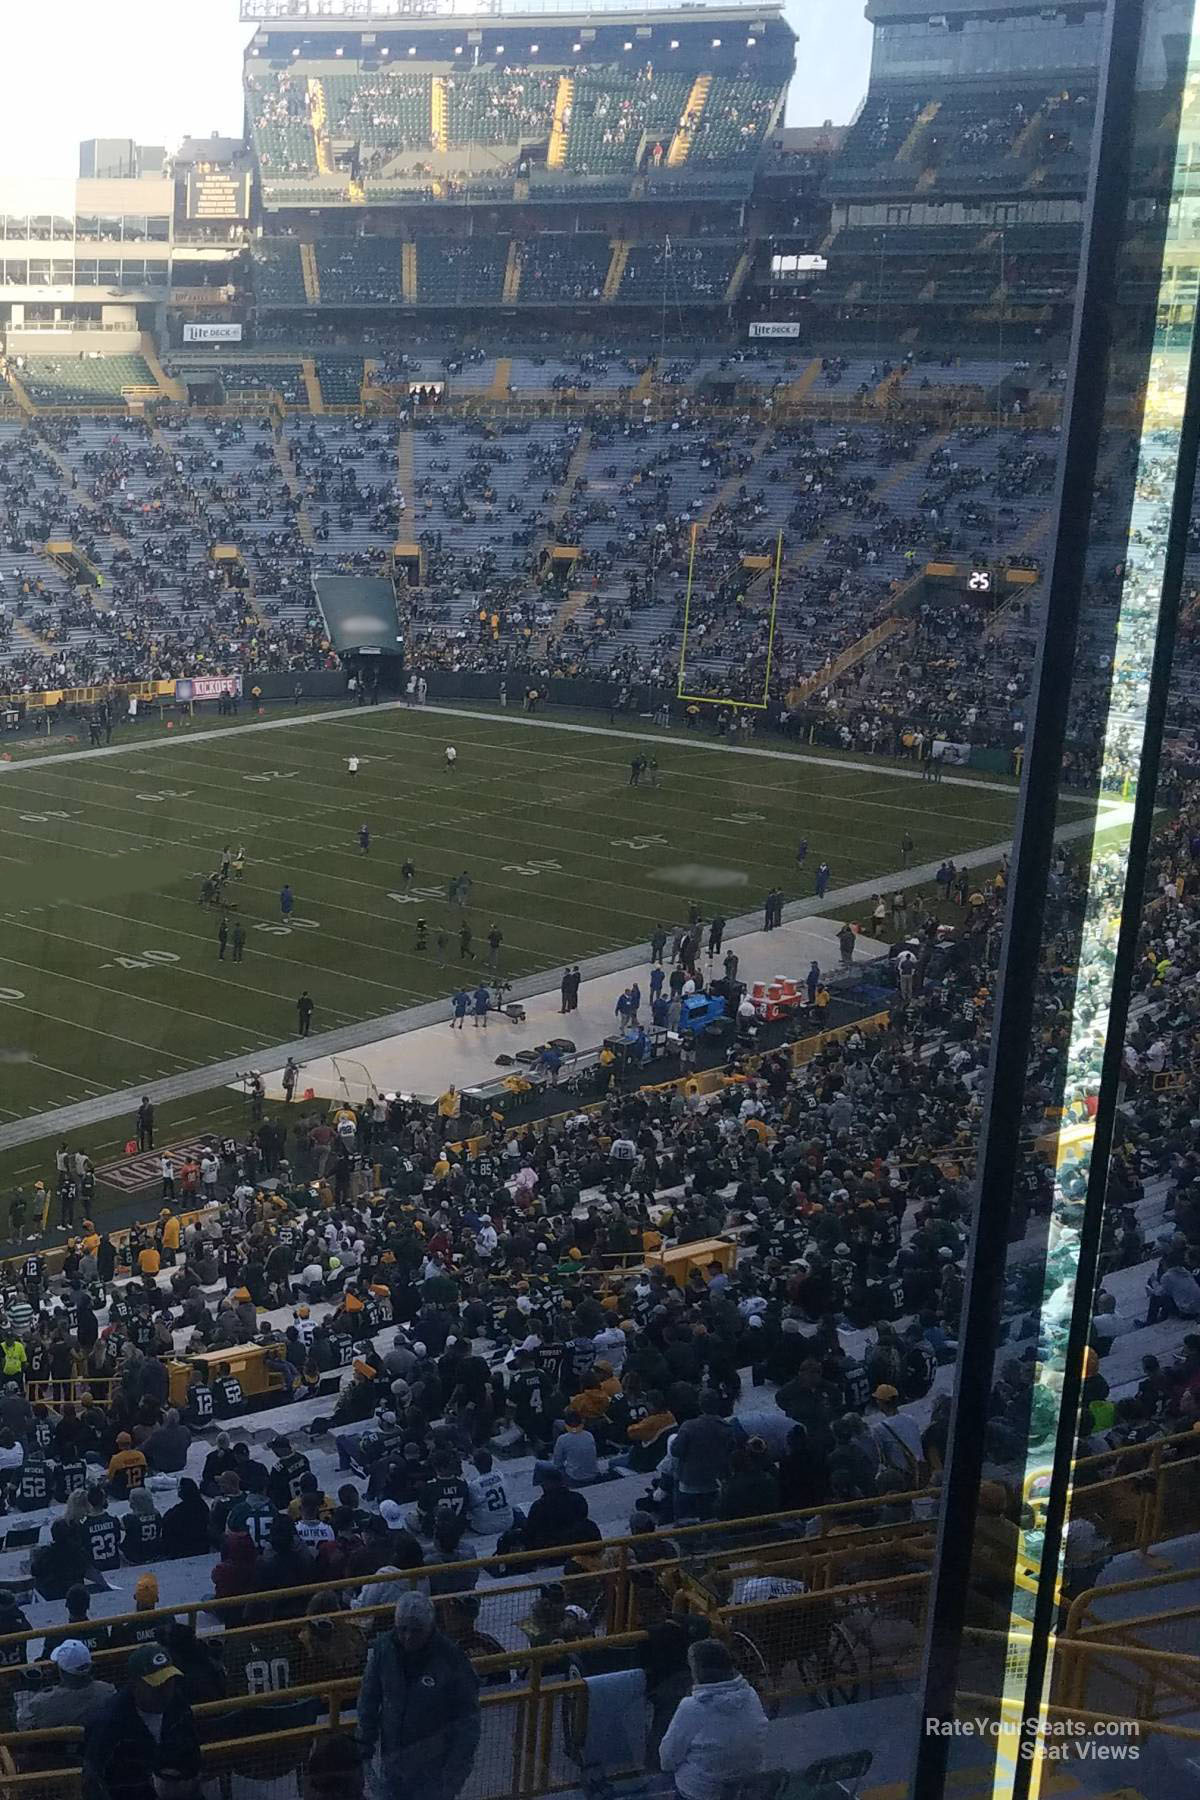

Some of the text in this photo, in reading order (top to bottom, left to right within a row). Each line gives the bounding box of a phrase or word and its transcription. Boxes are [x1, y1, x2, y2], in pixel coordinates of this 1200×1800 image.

[190, 327, 231, 341] Lite DECK
[969, 571, 990, 589] 25
[194, 680, 233, 696] KICKOFF
[500, 857, 560, 876] 30
[386, 885, 448, 904] 40
[252, 918, 321, 935] 50
[112, 950, 181, 969] 40
[618, 1147, 629, 1157] 12
[480, 1163, 492, 1176] 85
[280, 1231, 293, 1244] 52
[26, 1262, 38, 1276] 12
[118, 1303, 127, 1316] 12
[339, 1346, 353, 1365] 12
[225, 1385, 242, 1404] 52
[530, 1388, 543, 1413] 4
[197, 1394, 213, 1416] 12
[35, 1426, 51, 1447] 15
[22, 1477, 47, 1498] 52
[64, 1473, 85, 1495] 12
[126, 1467, 142, 1489] 12
[485, 1486, 509, 1512] 21
[91, 1533, 116, 1560] 23
[245, 1658, 290, 1697] 80
